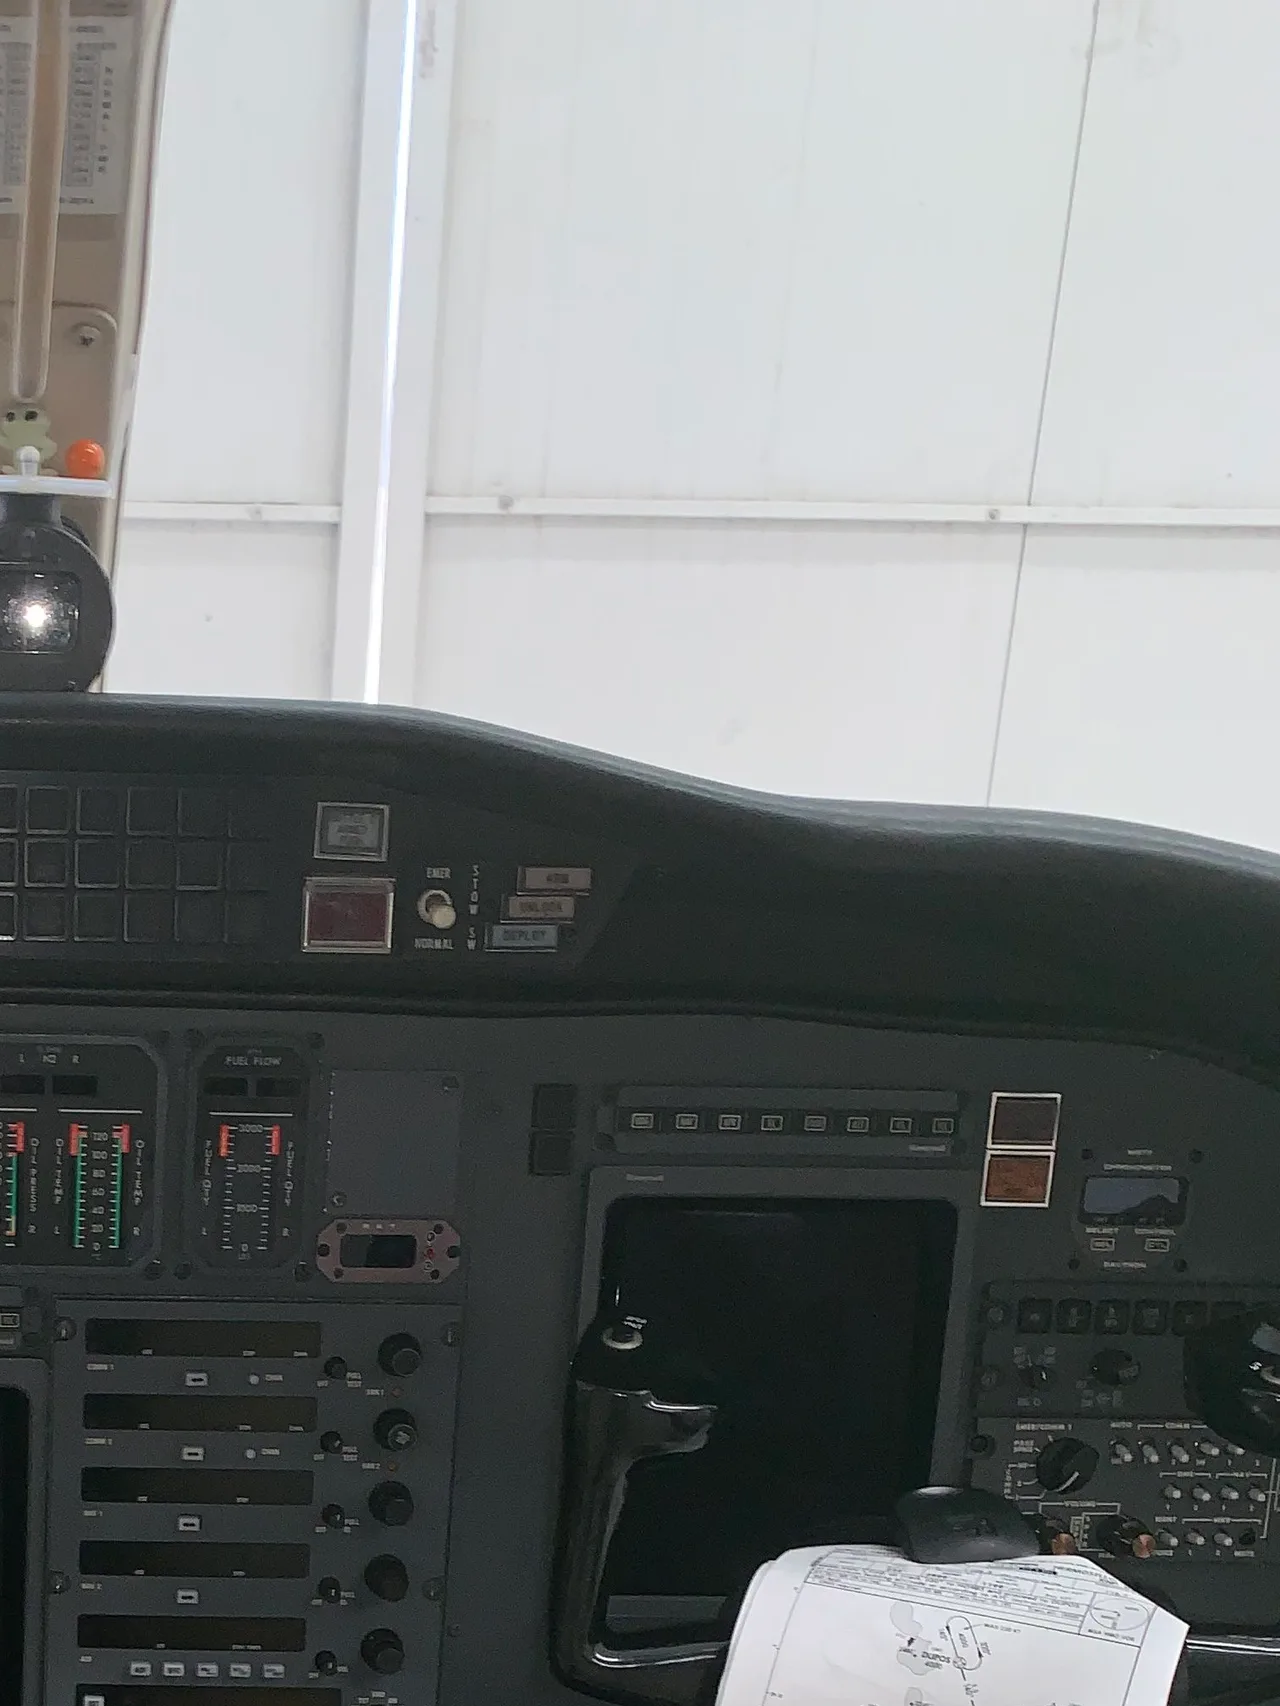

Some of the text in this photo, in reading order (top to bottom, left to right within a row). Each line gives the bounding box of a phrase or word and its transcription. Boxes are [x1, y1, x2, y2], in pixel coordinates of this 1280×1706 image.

[470, 864, 480, 915] STOW
[414, 938, 454, 950] NORMAL
[224, 1055, 282, 1066] FUEL FLOW
[238, 1123, 264, 1133] 3000
[29, 1169, 38, 1212] PRESS
[133, 1172, 144, 1206] TEMP
[922, 1651, 951, 1664] DUPOS
